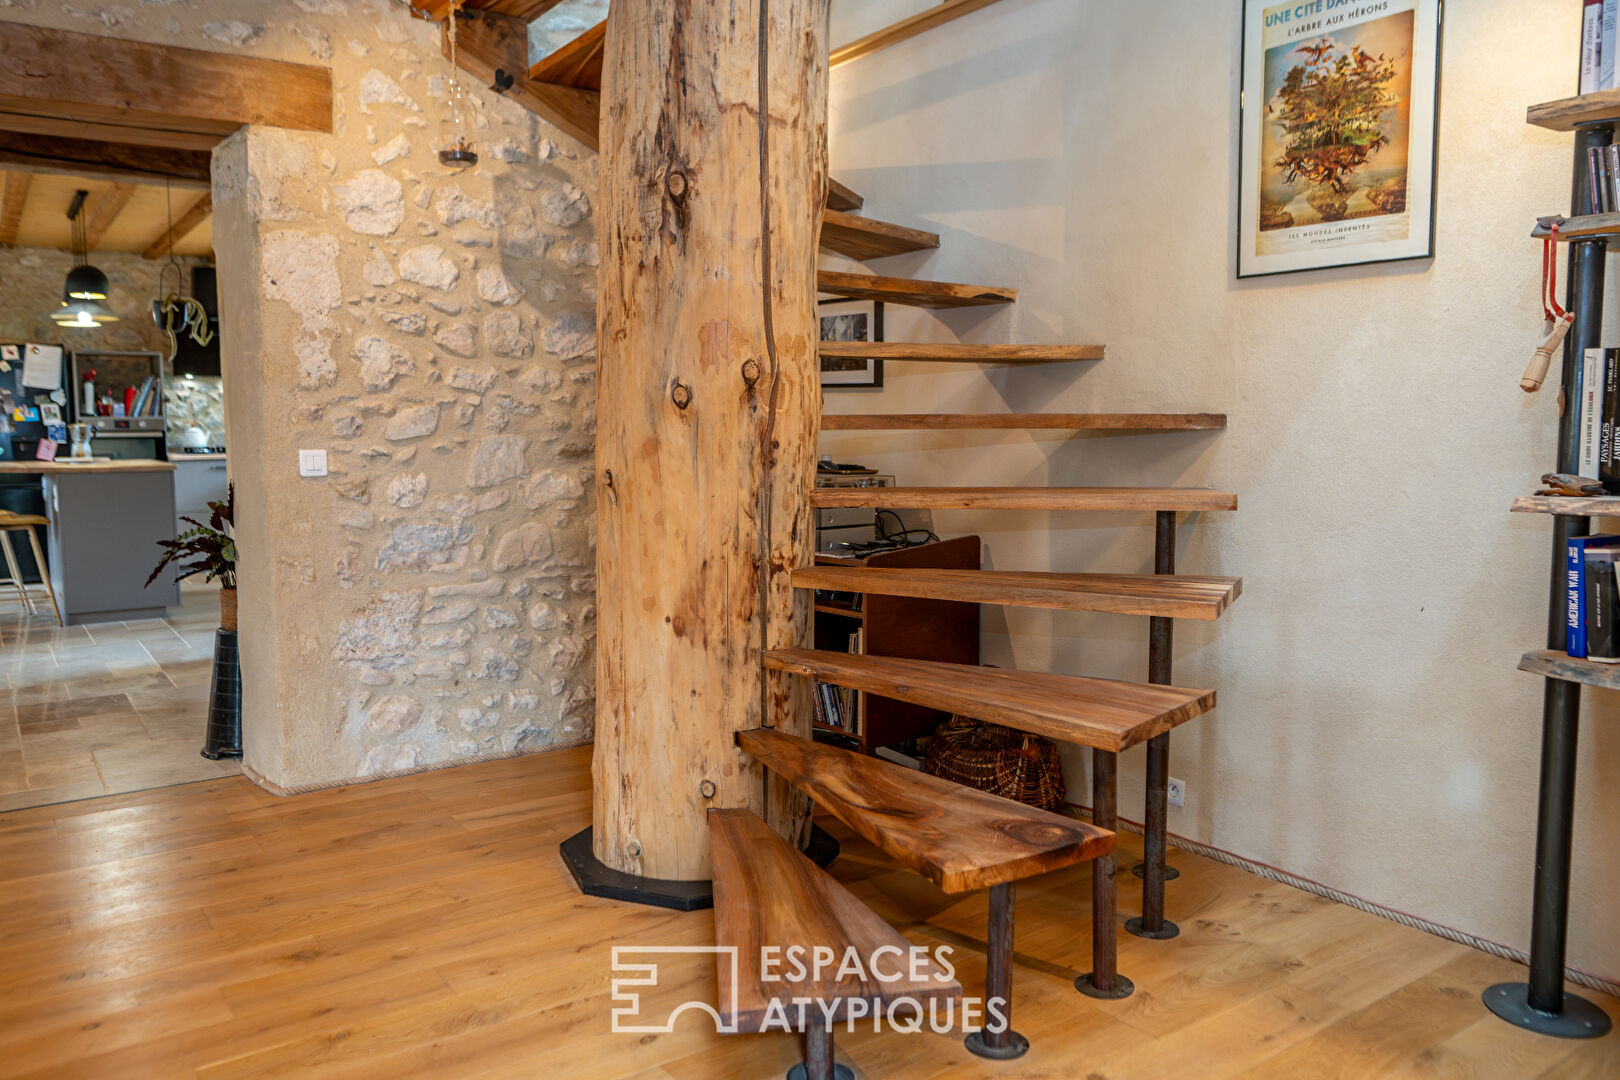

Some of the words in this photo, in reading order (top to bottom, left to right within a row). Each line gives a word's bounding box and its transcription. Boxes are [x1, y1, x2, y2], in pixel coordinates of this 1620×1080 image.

[1265, 10, 1291, 28] UNE
[1294, 0, 1323, 18] CITÉ
[1288, 21, 1322, 37] L'ARBRE
[1326, 14, 1344, 26] AUX
[1348, 1, 1388, 20] HÉRONS
[1600, 422, 1610, 463] PAYSAGES
[1567, 570, 1579, 588] WAR
[1567, 590, 1579, 629] AMERICAN
